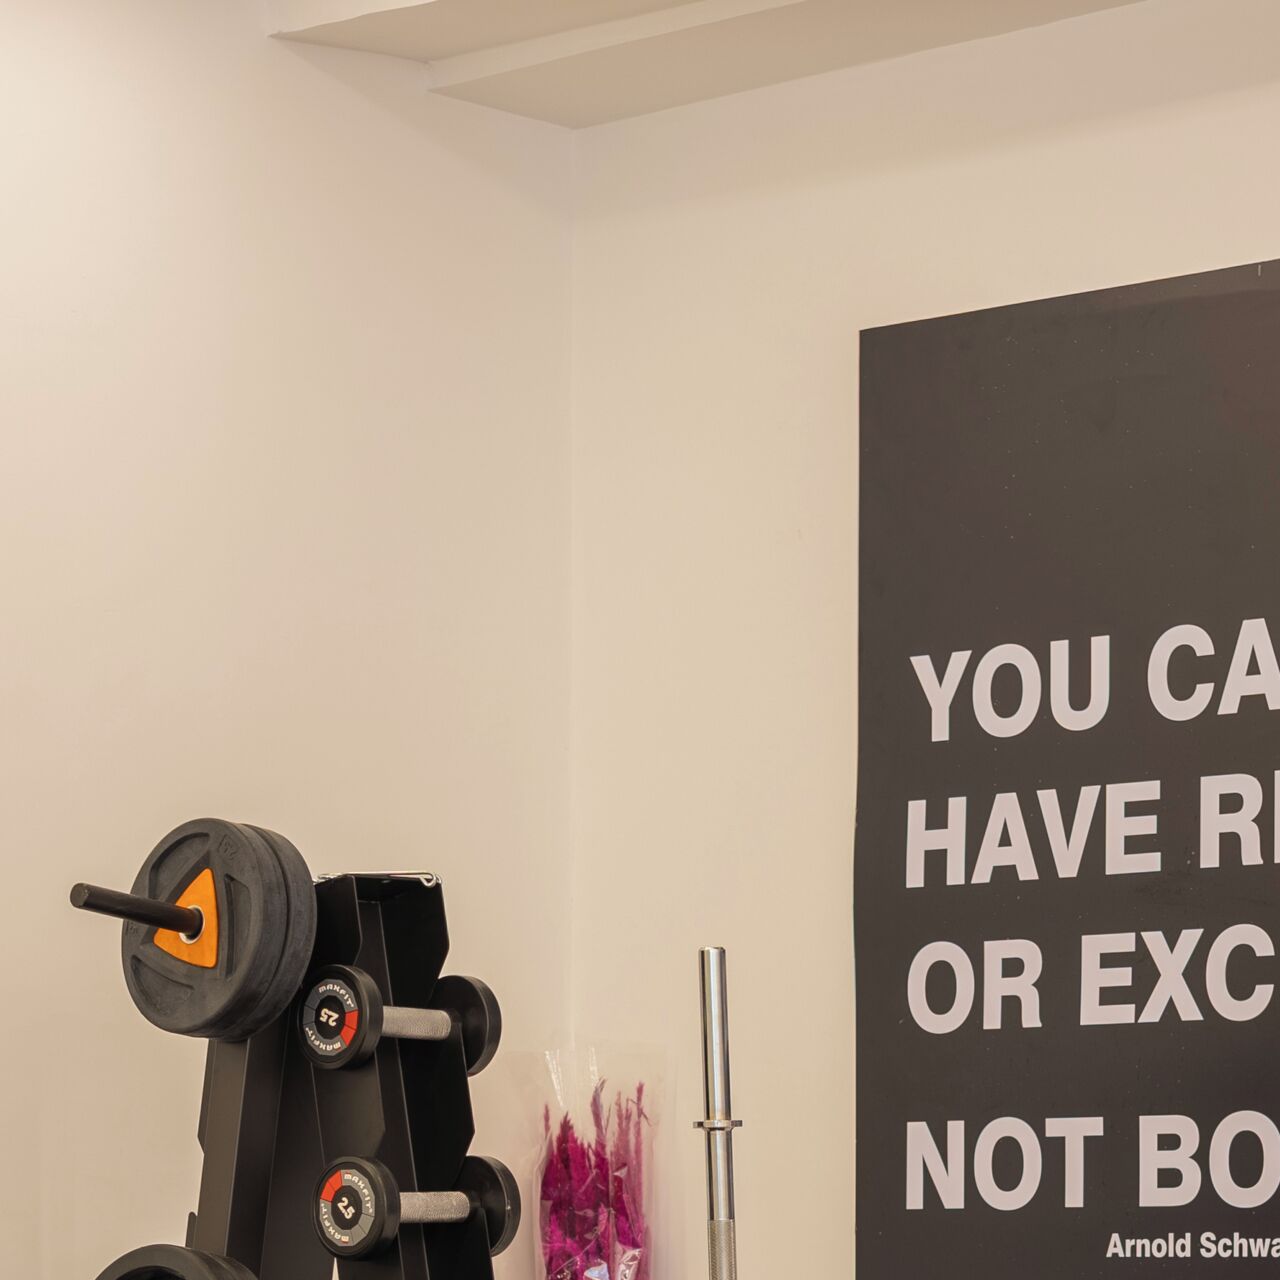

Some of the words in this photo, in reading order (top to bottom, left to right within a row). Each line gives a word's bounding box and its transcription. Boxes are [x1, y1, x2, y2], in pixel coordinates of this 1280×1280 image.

[910, 635, 1110, 742] YOU
[906, 780, 1161, 888] HAVE
[907, 939, 1042, 1034] OR
[905, 1117, 1103, 1210] NOT
[1106, 1232, 1191, 1258] Arnold
